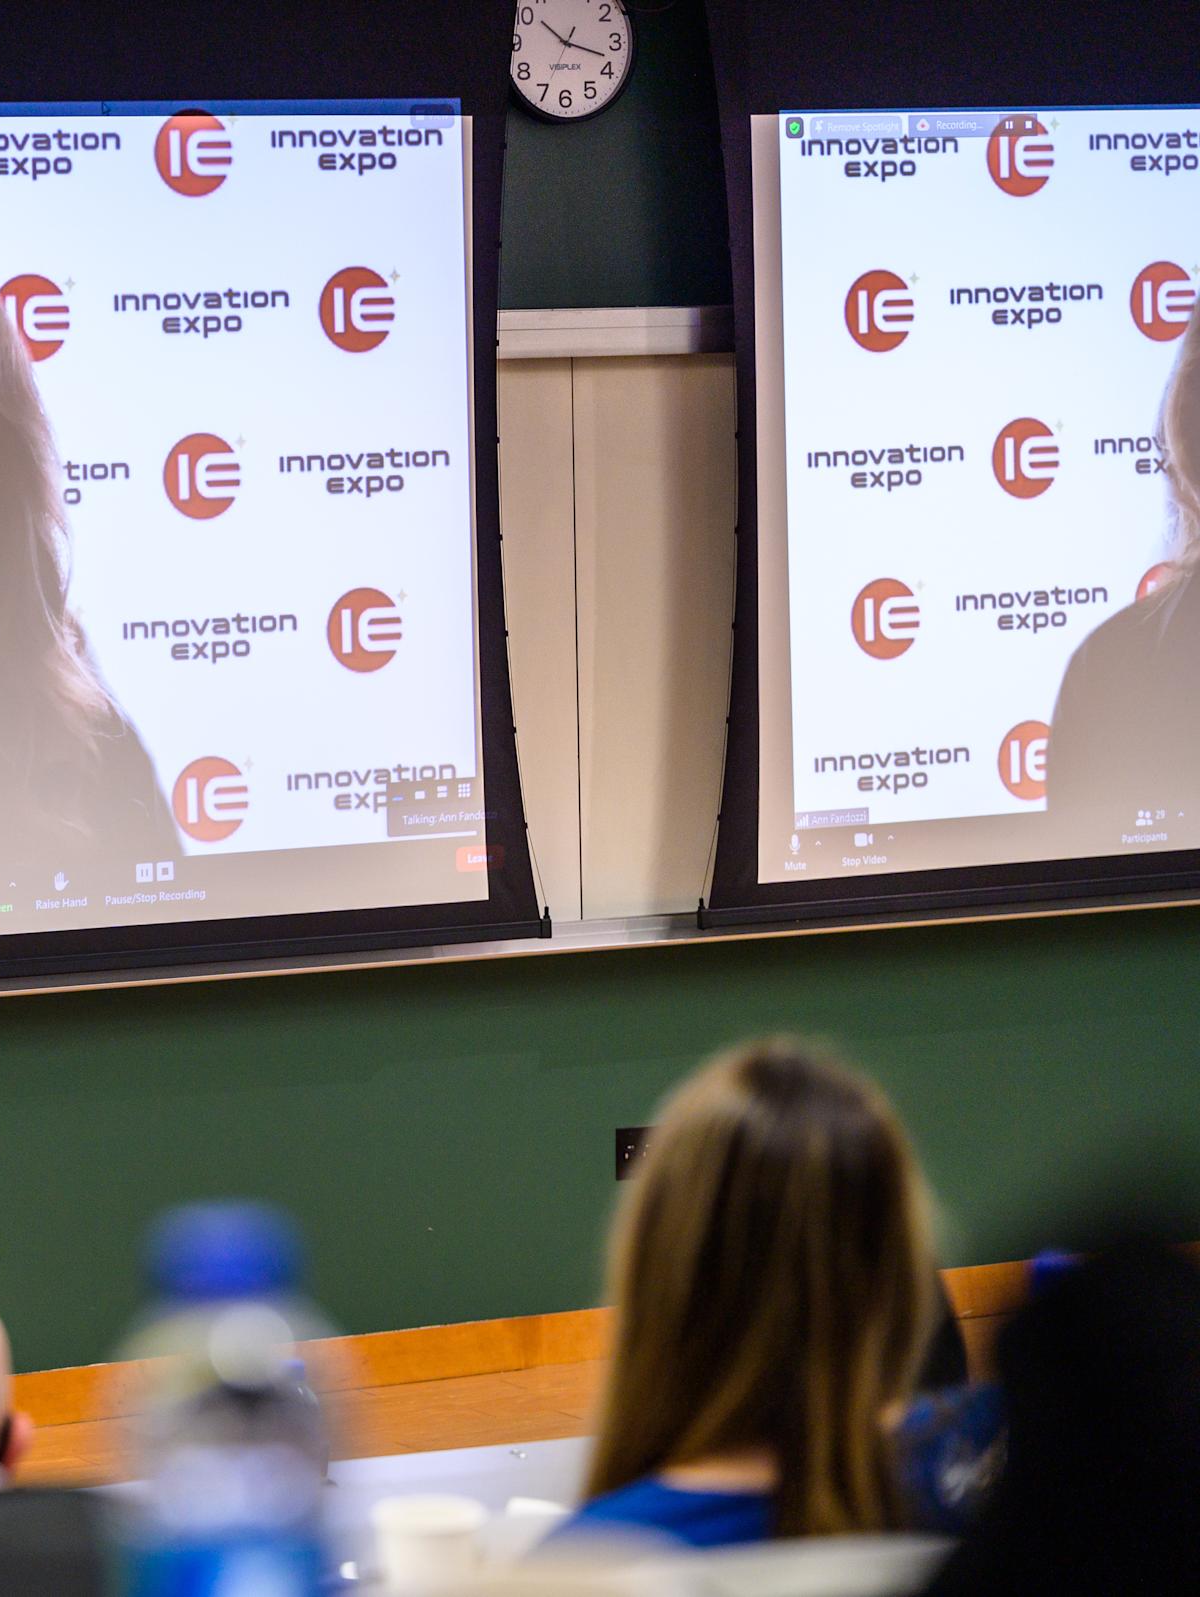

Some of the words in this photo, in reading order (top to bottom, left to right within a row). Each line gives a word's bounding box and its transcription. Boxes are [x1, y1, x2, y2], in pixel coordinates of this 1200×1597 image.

[598, 3, 612, 22] 2
[608, 32, 622, 51] 3
[517, 62, 531, 80] 8
[549, 63, 581, 71] VISIPLEX
[600, 61, 614, 79] 4
[536, 83, 549, 102] 7
[558, 89, 572, 108] 6
[583, 81, 597, 99] 5
[270, 126, 443, 149] innovation
[318, 153, 397, 175] expo
[844, 160, 916, 182] expo
[1130, 155, 1199, 176] expo
[113, 288, 289, 312] innovation
[950, 283, 1103, 304] innovation
[162, 314, 242, 338] expo
[992, 307, 1061, 329] expo
[279, 449, 449, 473] innovation
[807, 444, 964, 468] innovation
[326, 475, 404, 497] expo
[850, 470, 921, 491] expo
[955, 587, 1108, 611] innovation
[123, 613, 297, 640] innovation
[997, 611, 1067, 634] expo
[171, 639, 250, 664] expo
[814, 746, 970, 773] innovation
[857, 771, 928, 795] expo
[334, 791, 387, 813] exp
[402, 813, 437, 826] Talking:
[439, 813, 457, 822] Ann
[1121, 832, 1168, 844] Participants
[784, 861, 807, 871] Mute
[842, 856, 861, 867] Stop
[862, 855, 887, 865] Video
[35, 899, 60, 910] Raise
[62, 897, 88, 908] Hand
[105, 893, 157, 906] Pause/Stop
[159, 888, 206, 903] Recording
